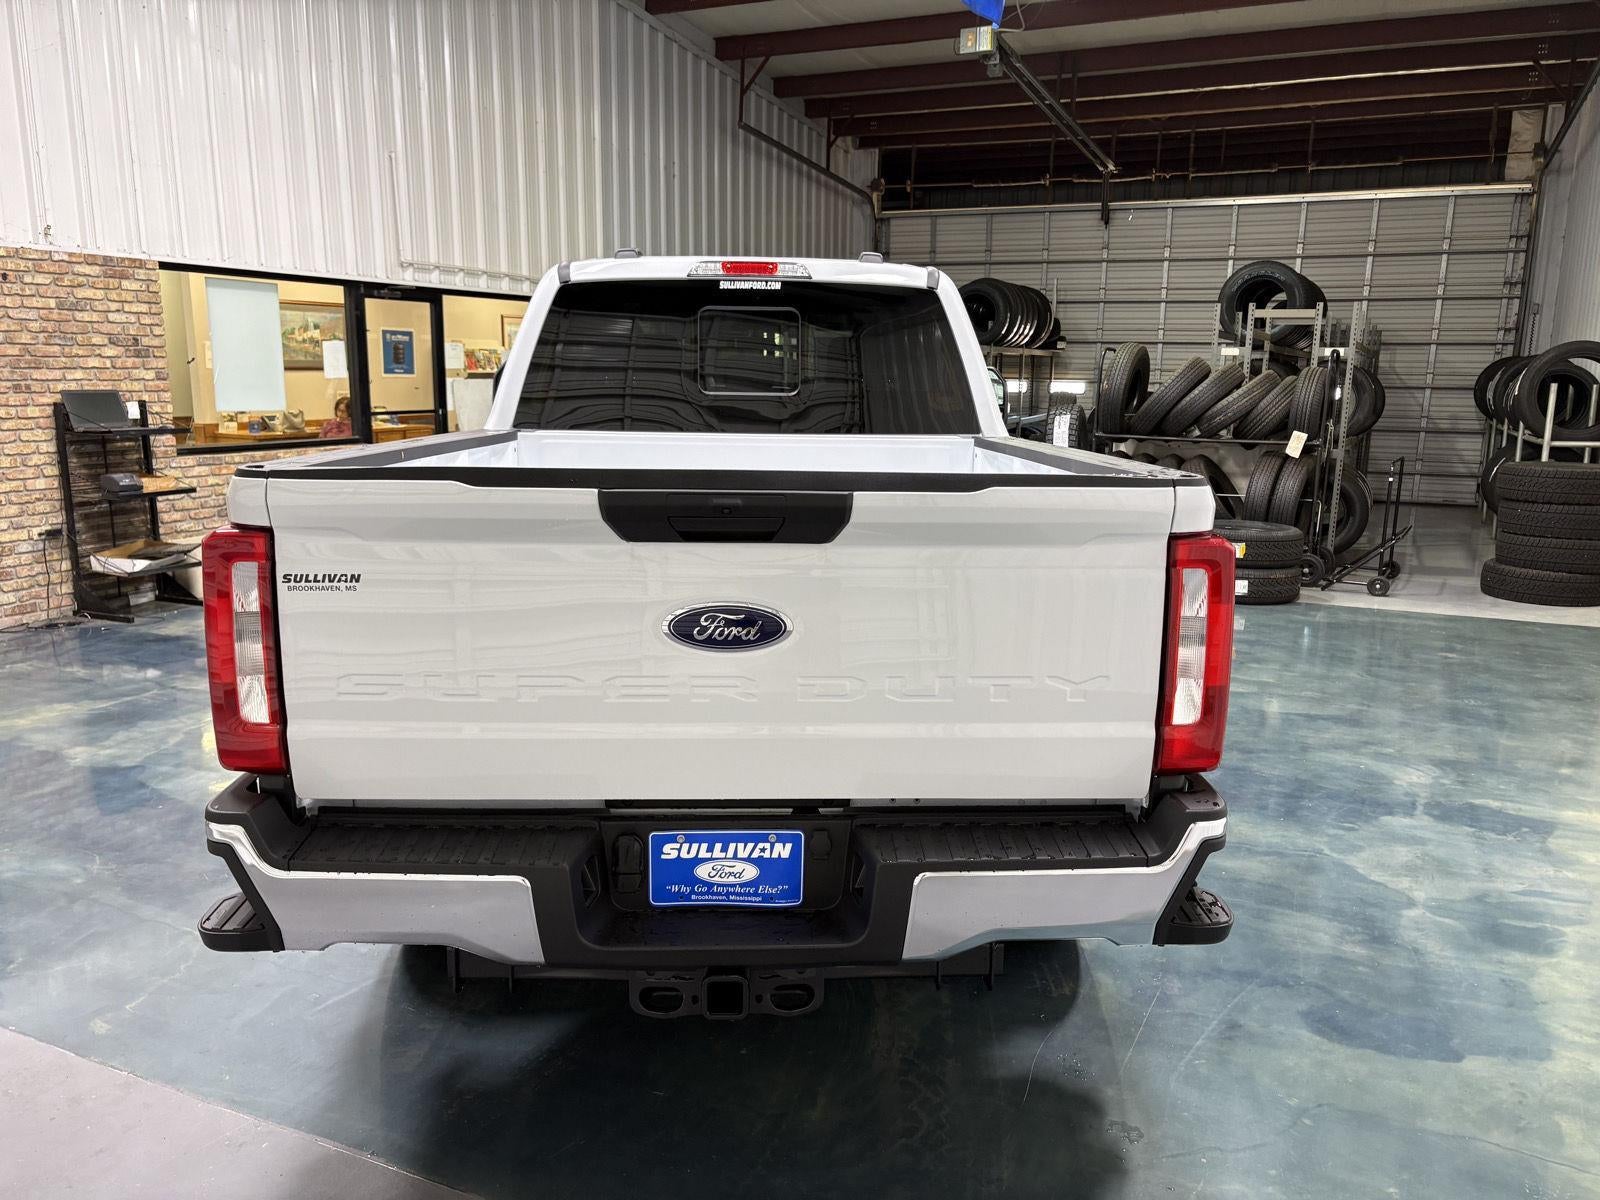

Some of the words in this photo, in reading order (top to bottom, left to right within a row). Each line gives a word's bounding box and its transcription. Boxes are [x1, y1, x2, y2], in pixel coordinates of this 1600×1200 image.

[719, 281, 781, 290] SULLIVANFORD.COM
[281, 573, 361, 584] SULLIVAN
[693, 612, 763, 641] Ford
[337, 673, 758, 703] SUPER
[796, 674, 1111, 703] DUTY
[660, 842, 793, 860] SULLIVAN
[707, 863, 745, 880] Ford
[694, 884, 708, 893] Go
[709, 885, 756, 895] Anywhere
